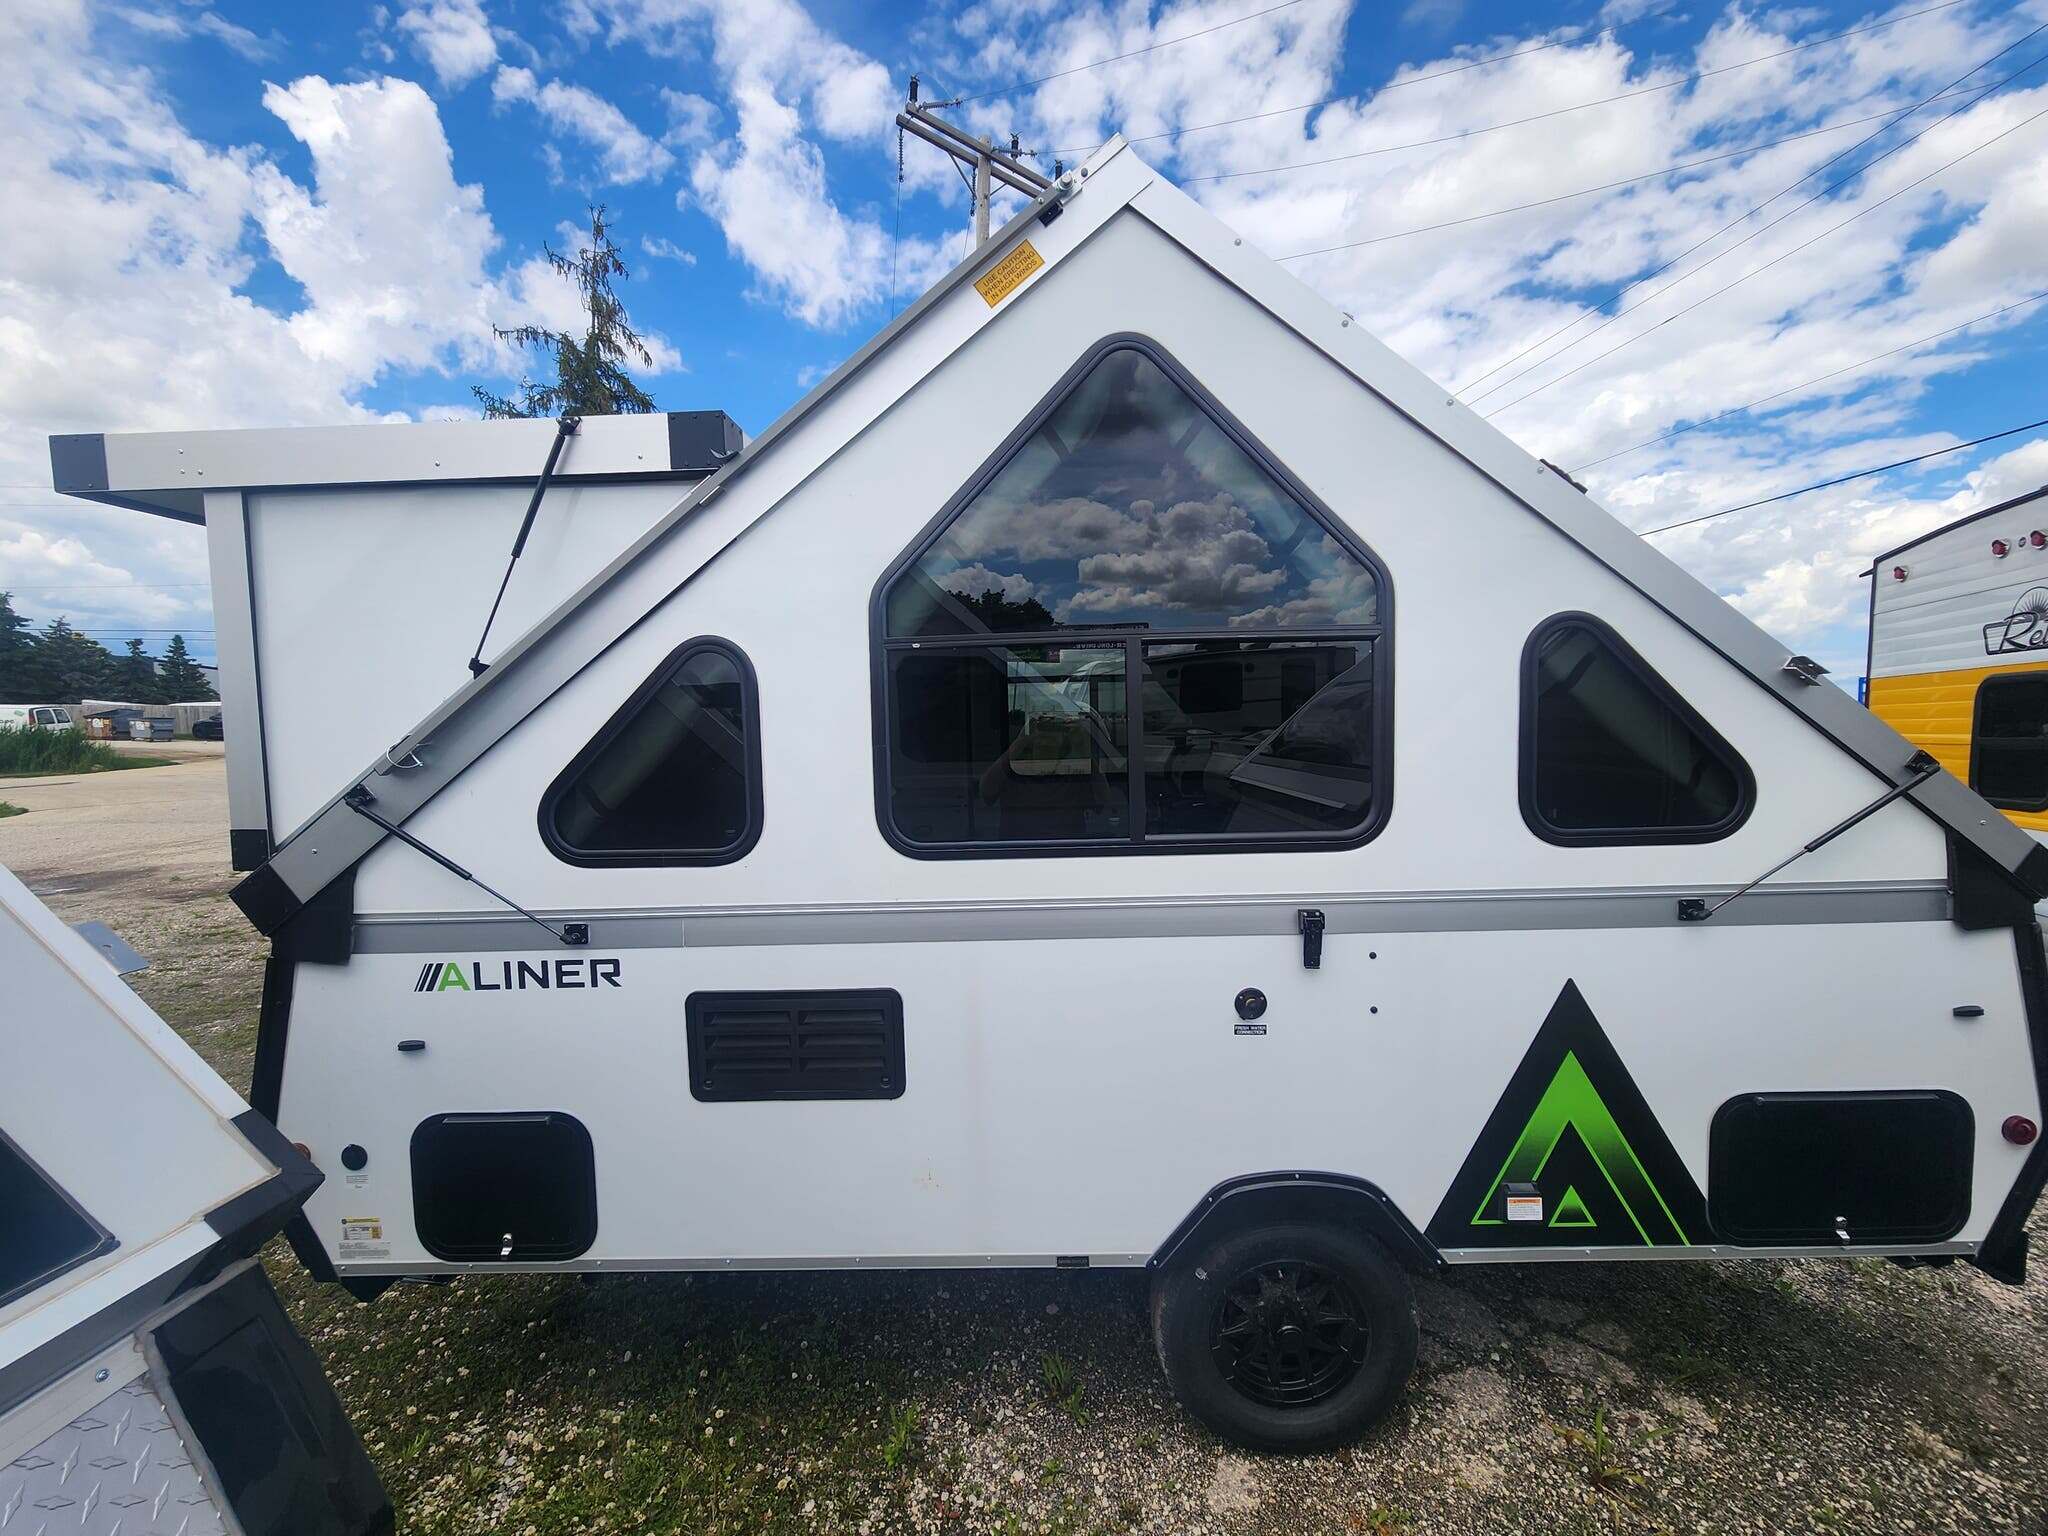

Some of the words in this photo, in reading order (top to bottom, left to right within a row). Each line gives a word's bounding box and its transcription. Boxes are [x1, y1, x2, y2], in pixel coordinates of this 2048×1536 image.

[982, 278, 1003, 297] WHEN
[1003, 250, 1036, 280] ERECTING
[983, 273, 998, 287] USE
[997, 248, 1026, 275] CAUTION
[991, 292, 999, 301] IN
[998, 278, 1016, 293] HIGH
[1014, 259, 1038, 280] WINDS
[437, 958, 622, 992] ALINER
